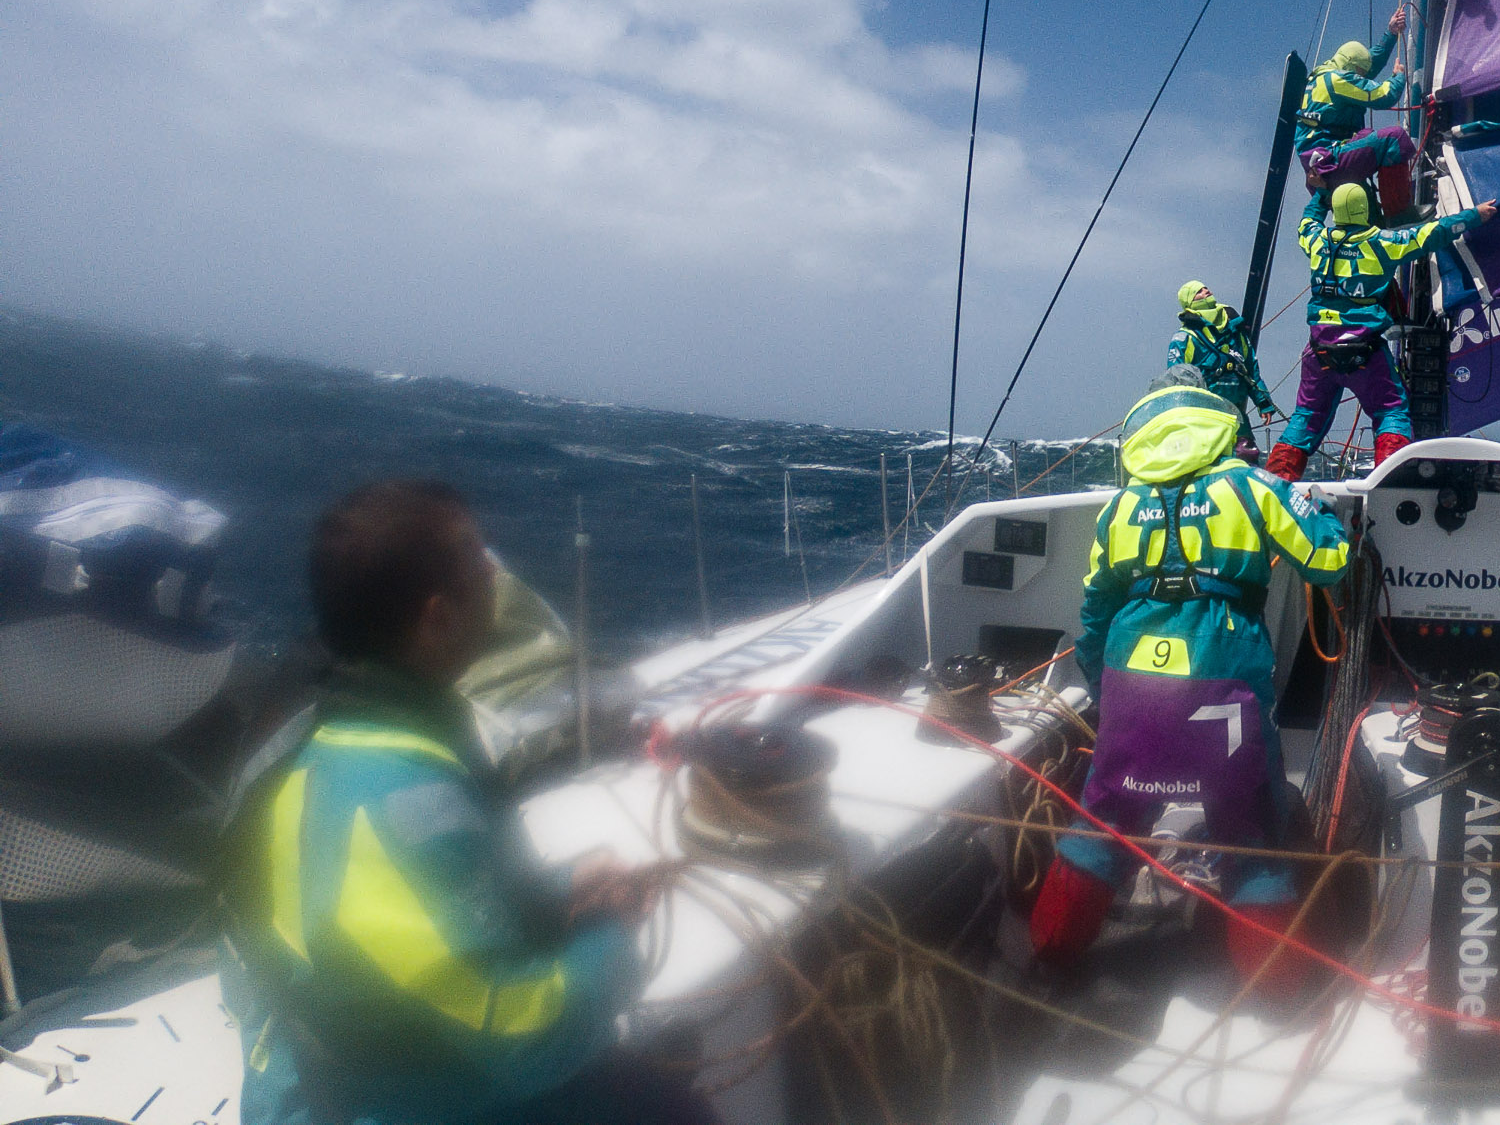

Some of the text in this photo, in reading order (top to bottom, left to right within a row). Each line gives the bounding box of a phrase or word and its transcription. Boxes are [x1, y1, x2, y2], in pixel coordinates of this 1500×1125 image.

[1137, 501, 1211, 524] Akzobel
[1152, 640, 1172, 669] 9
[1122, 775, 1201, 795] AkzoNobel
